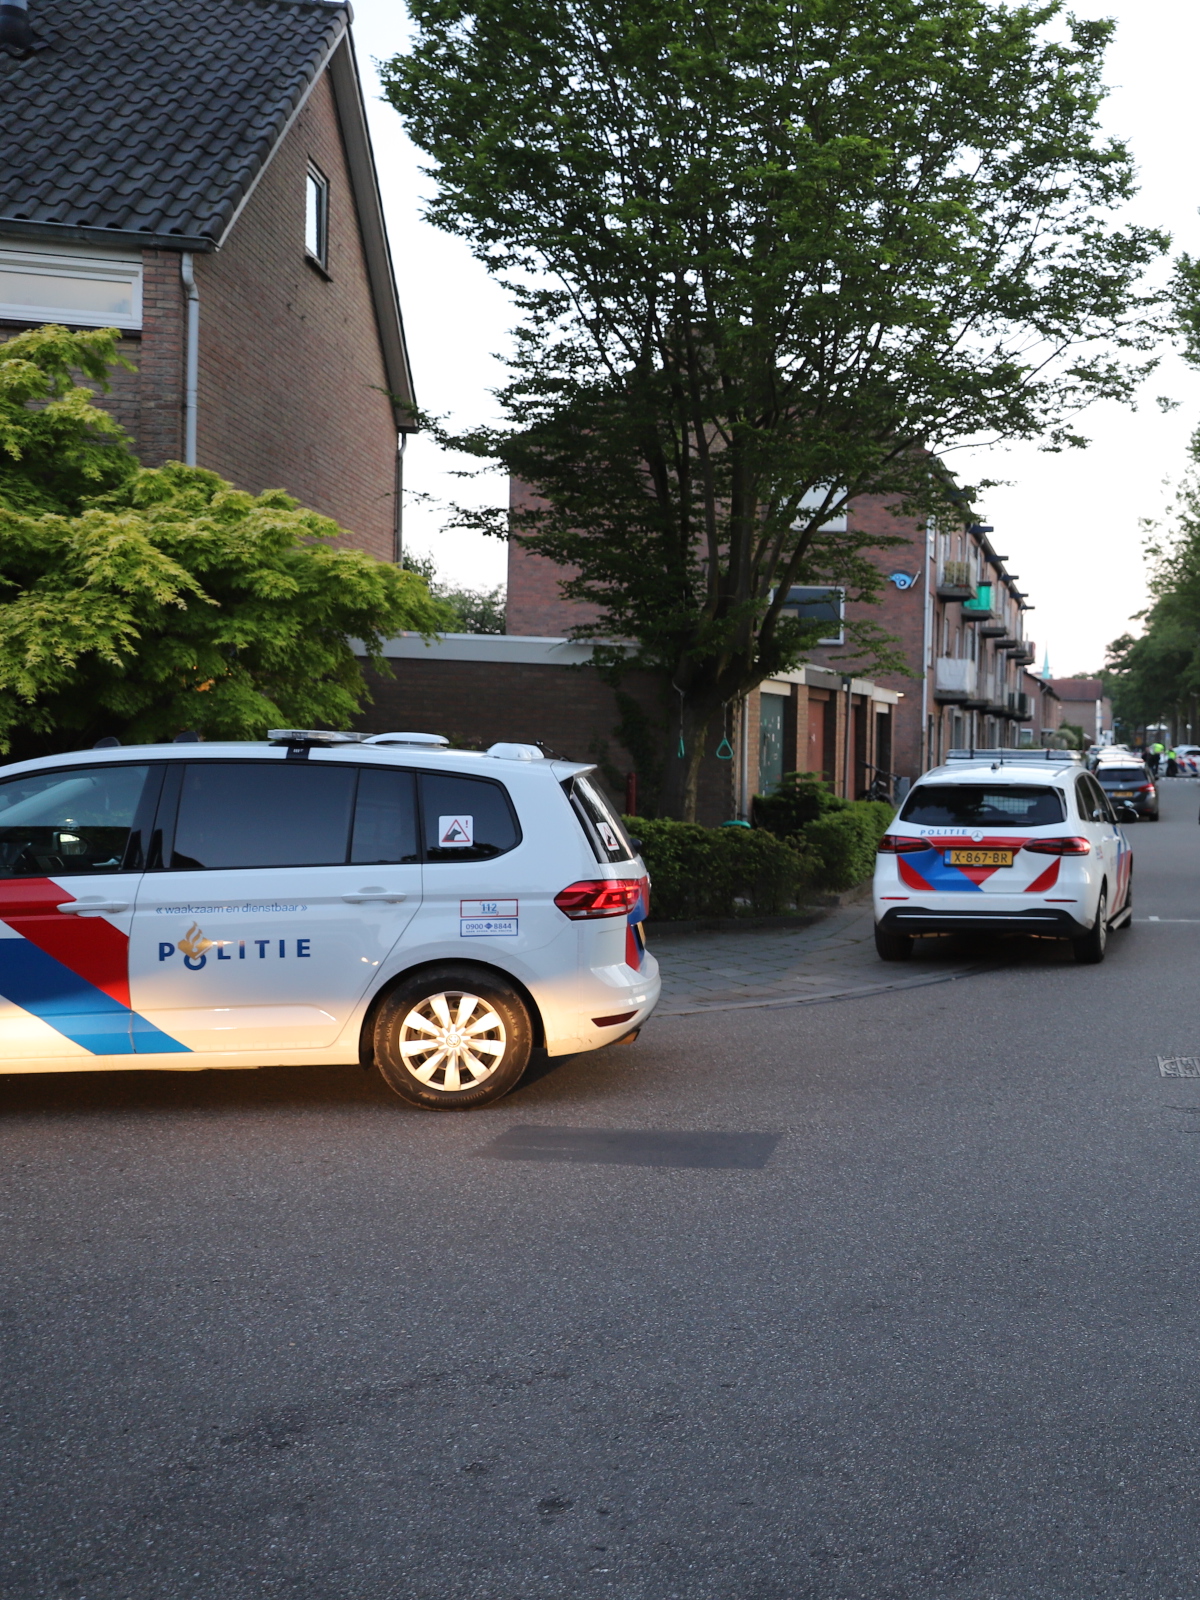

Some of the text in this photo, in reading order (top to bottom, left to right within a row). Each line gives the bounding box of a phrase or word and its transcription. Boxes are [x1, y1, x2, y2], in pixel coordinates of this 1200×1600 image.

[954, 852, 1008, 863] X-867-BR
[165, 904, 224, 914] waakzaam
[226, 905, 240, 913] en
[245, 903, 299, 914] dienstbaar
[481, 903, 497, 911] 112
[158, 938, 311, 971] POLITIE
